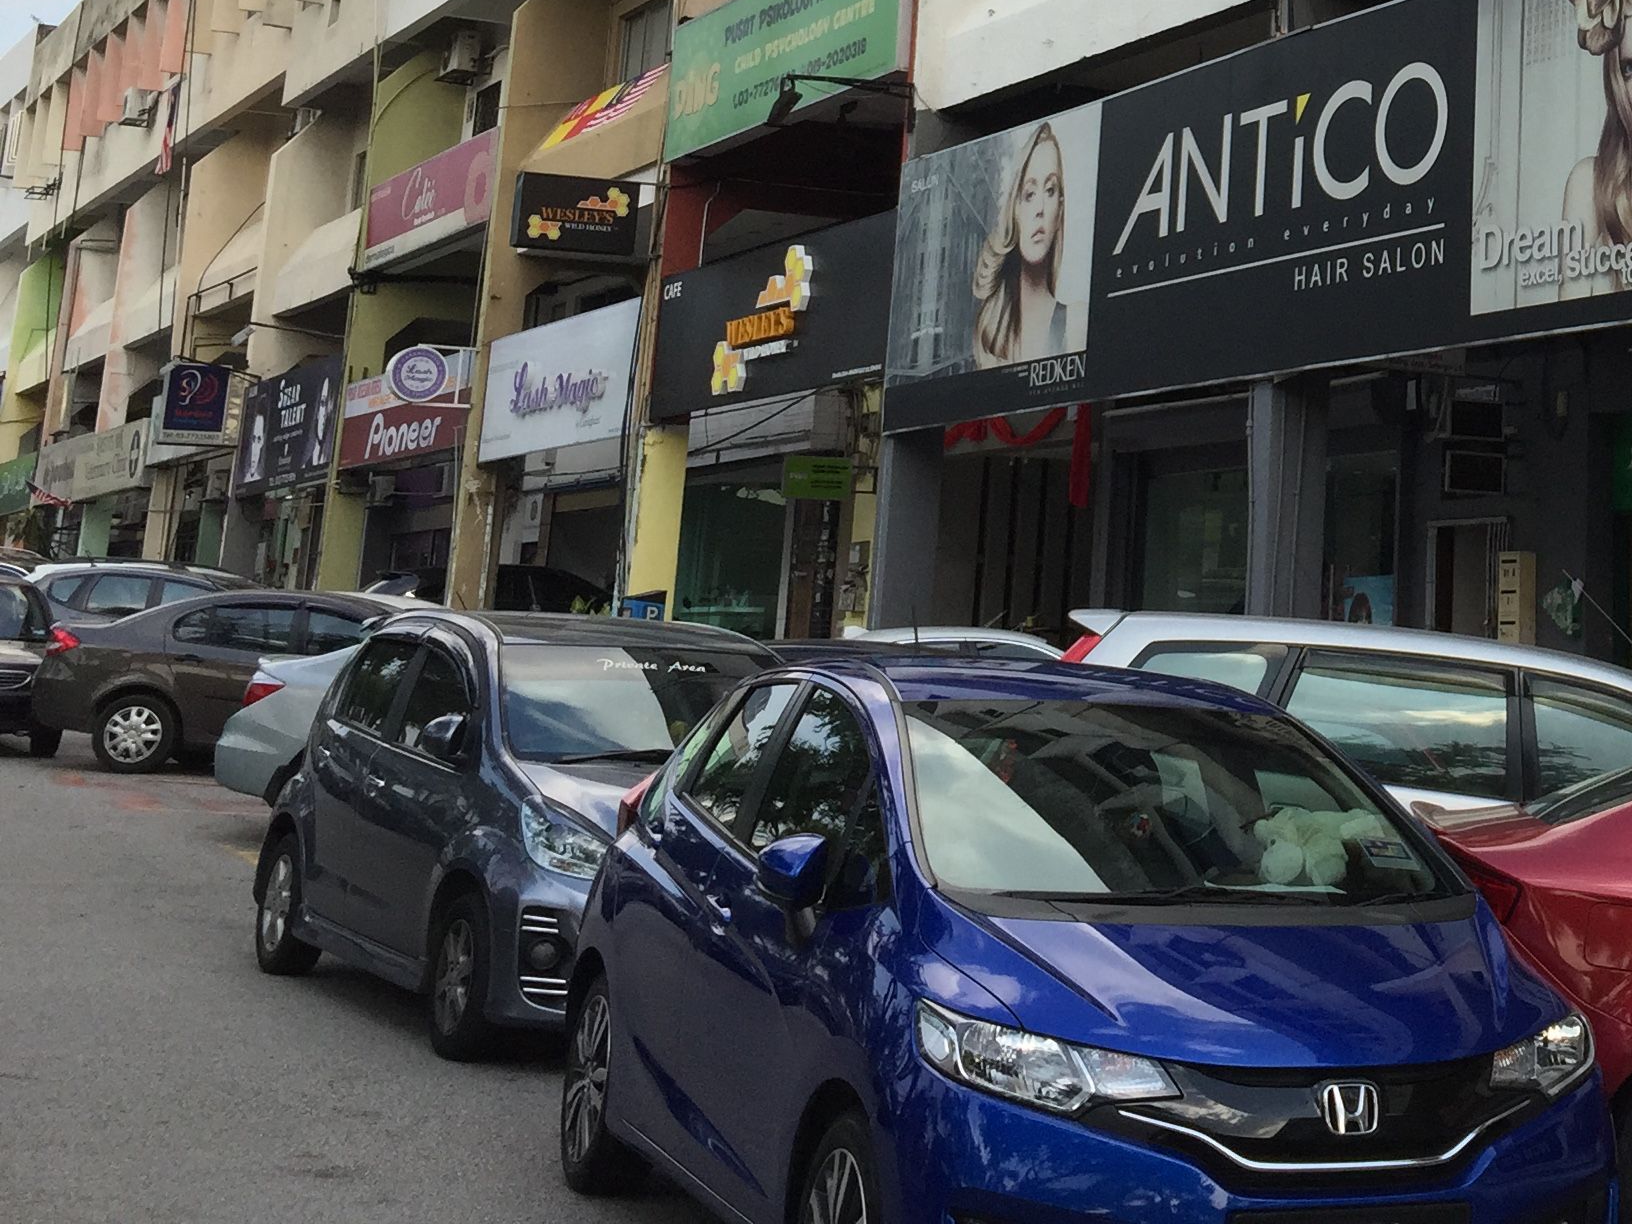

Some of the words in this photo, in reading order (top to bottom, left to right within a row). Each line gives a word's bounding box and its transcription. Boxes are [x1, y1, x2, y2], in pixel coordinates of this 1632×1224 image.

[541, 206, 615, 224] WESLEY'S
[1116, 237, 1255, 278] evolution
[1283, 196, 1436, 241] everyday
[1480, 218, 1584, 270] Dream
[1294, 257, 1349, 291] HAIR
[1362, 238, 1445, 278] SALON
[663, 281, 684, 301] CAFE
[509, 361, 549, 417] Lash
[551, 368, 605, 414] Magic
[1029, 353, 1087, 388] REDKEN
[363, 412, 442, 460] Pioneer
[646, 606, 659, 621] P
[596, 658, 659, 672] Private
[667, 661, 706, 673] Area
